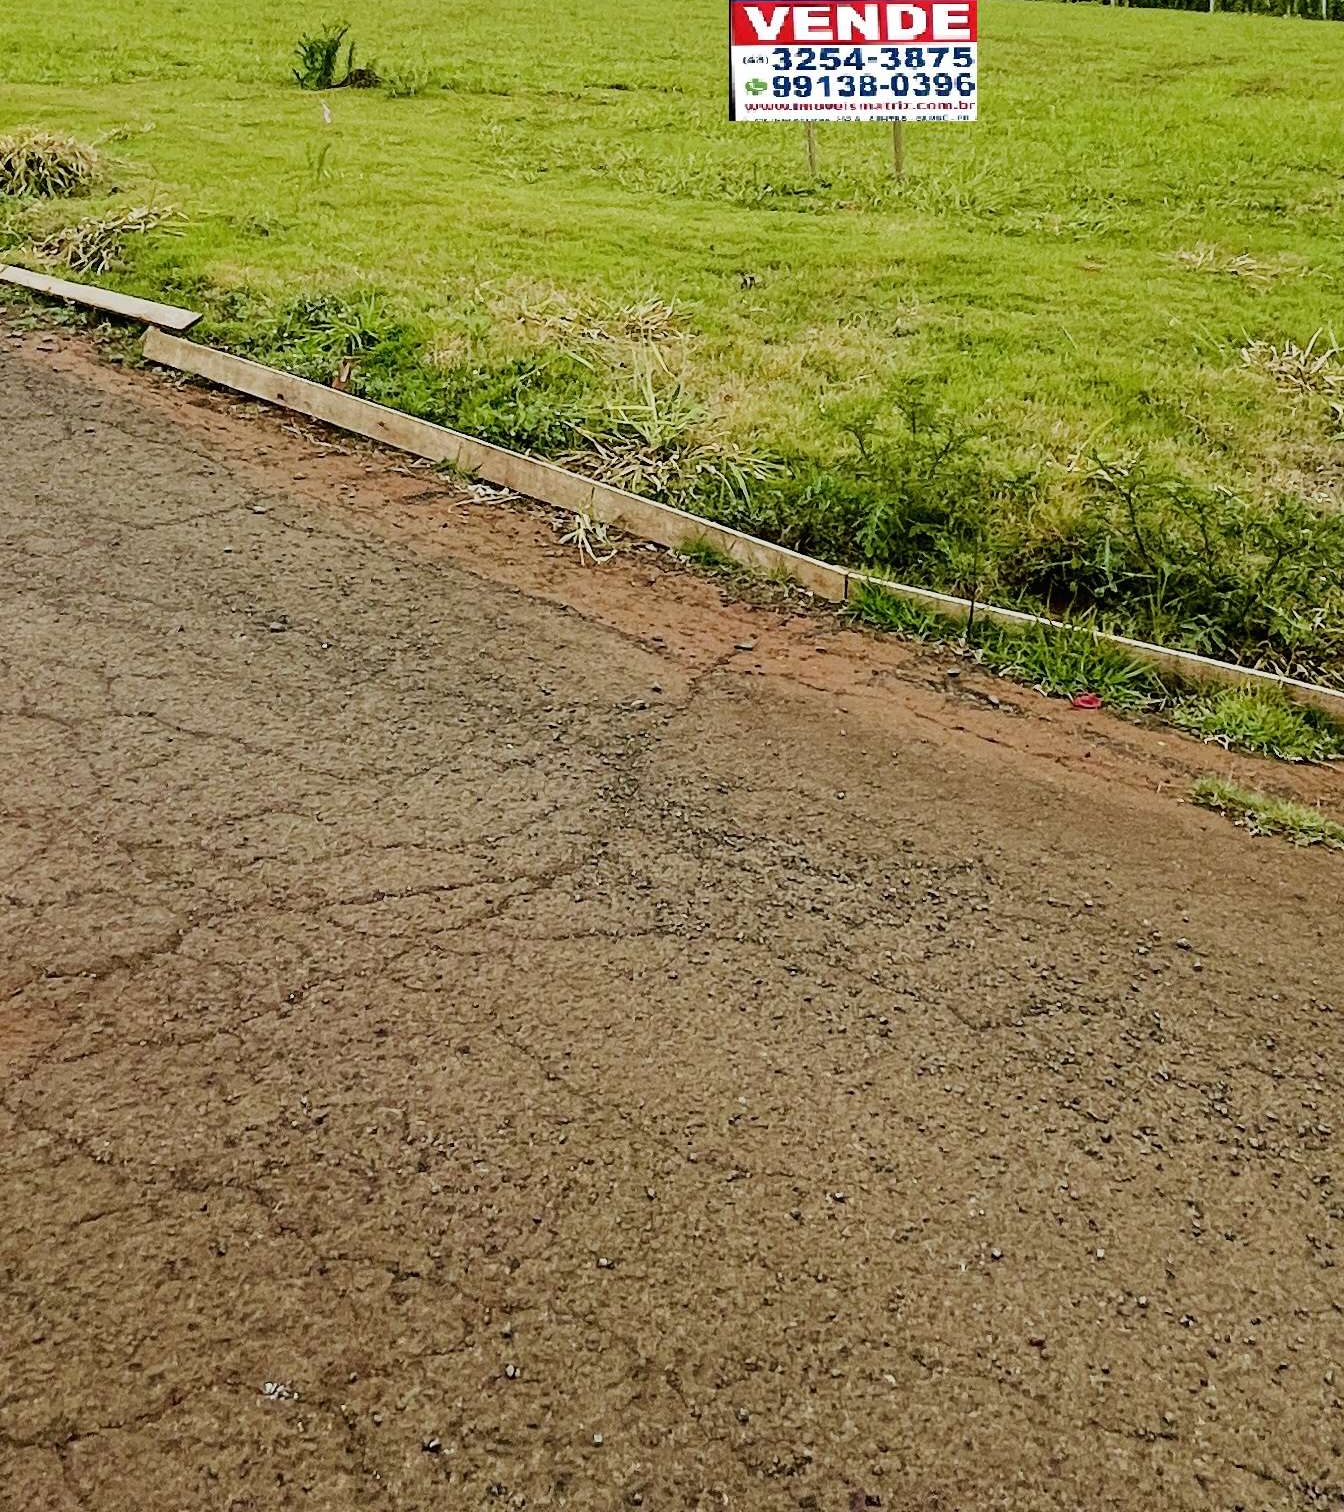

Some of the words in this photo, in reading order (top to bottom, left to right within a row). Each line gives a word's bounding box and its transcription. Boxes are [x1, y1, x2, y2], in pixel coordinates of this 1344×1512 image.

[742, 3, 972, 41] VENDE
[771, 47, 974, 71] 3254-3875
[771, 73, 976, 98] 99138-0396
